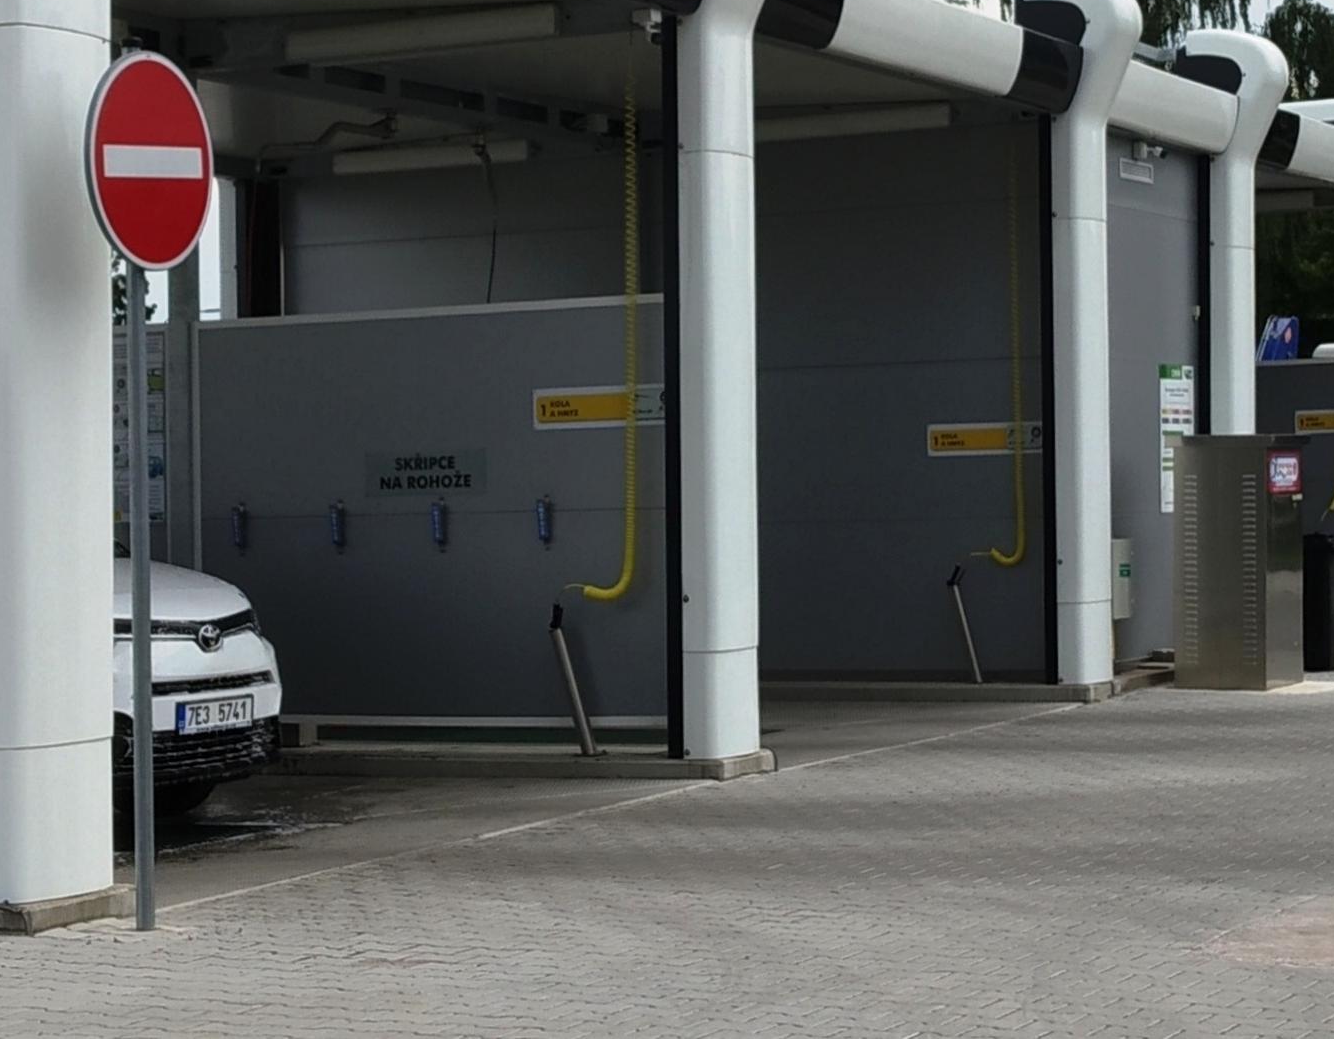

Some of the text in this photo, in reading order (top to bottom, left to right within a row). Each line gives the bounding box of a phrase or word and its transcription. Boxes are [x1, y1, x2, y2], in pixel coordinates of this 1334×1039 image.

[395, 452, 455, 471] SKŘIPCE
[380, 469, 471, 490] NA ROHOŽE
[188, 700, 247, 727] 7E3 5741
